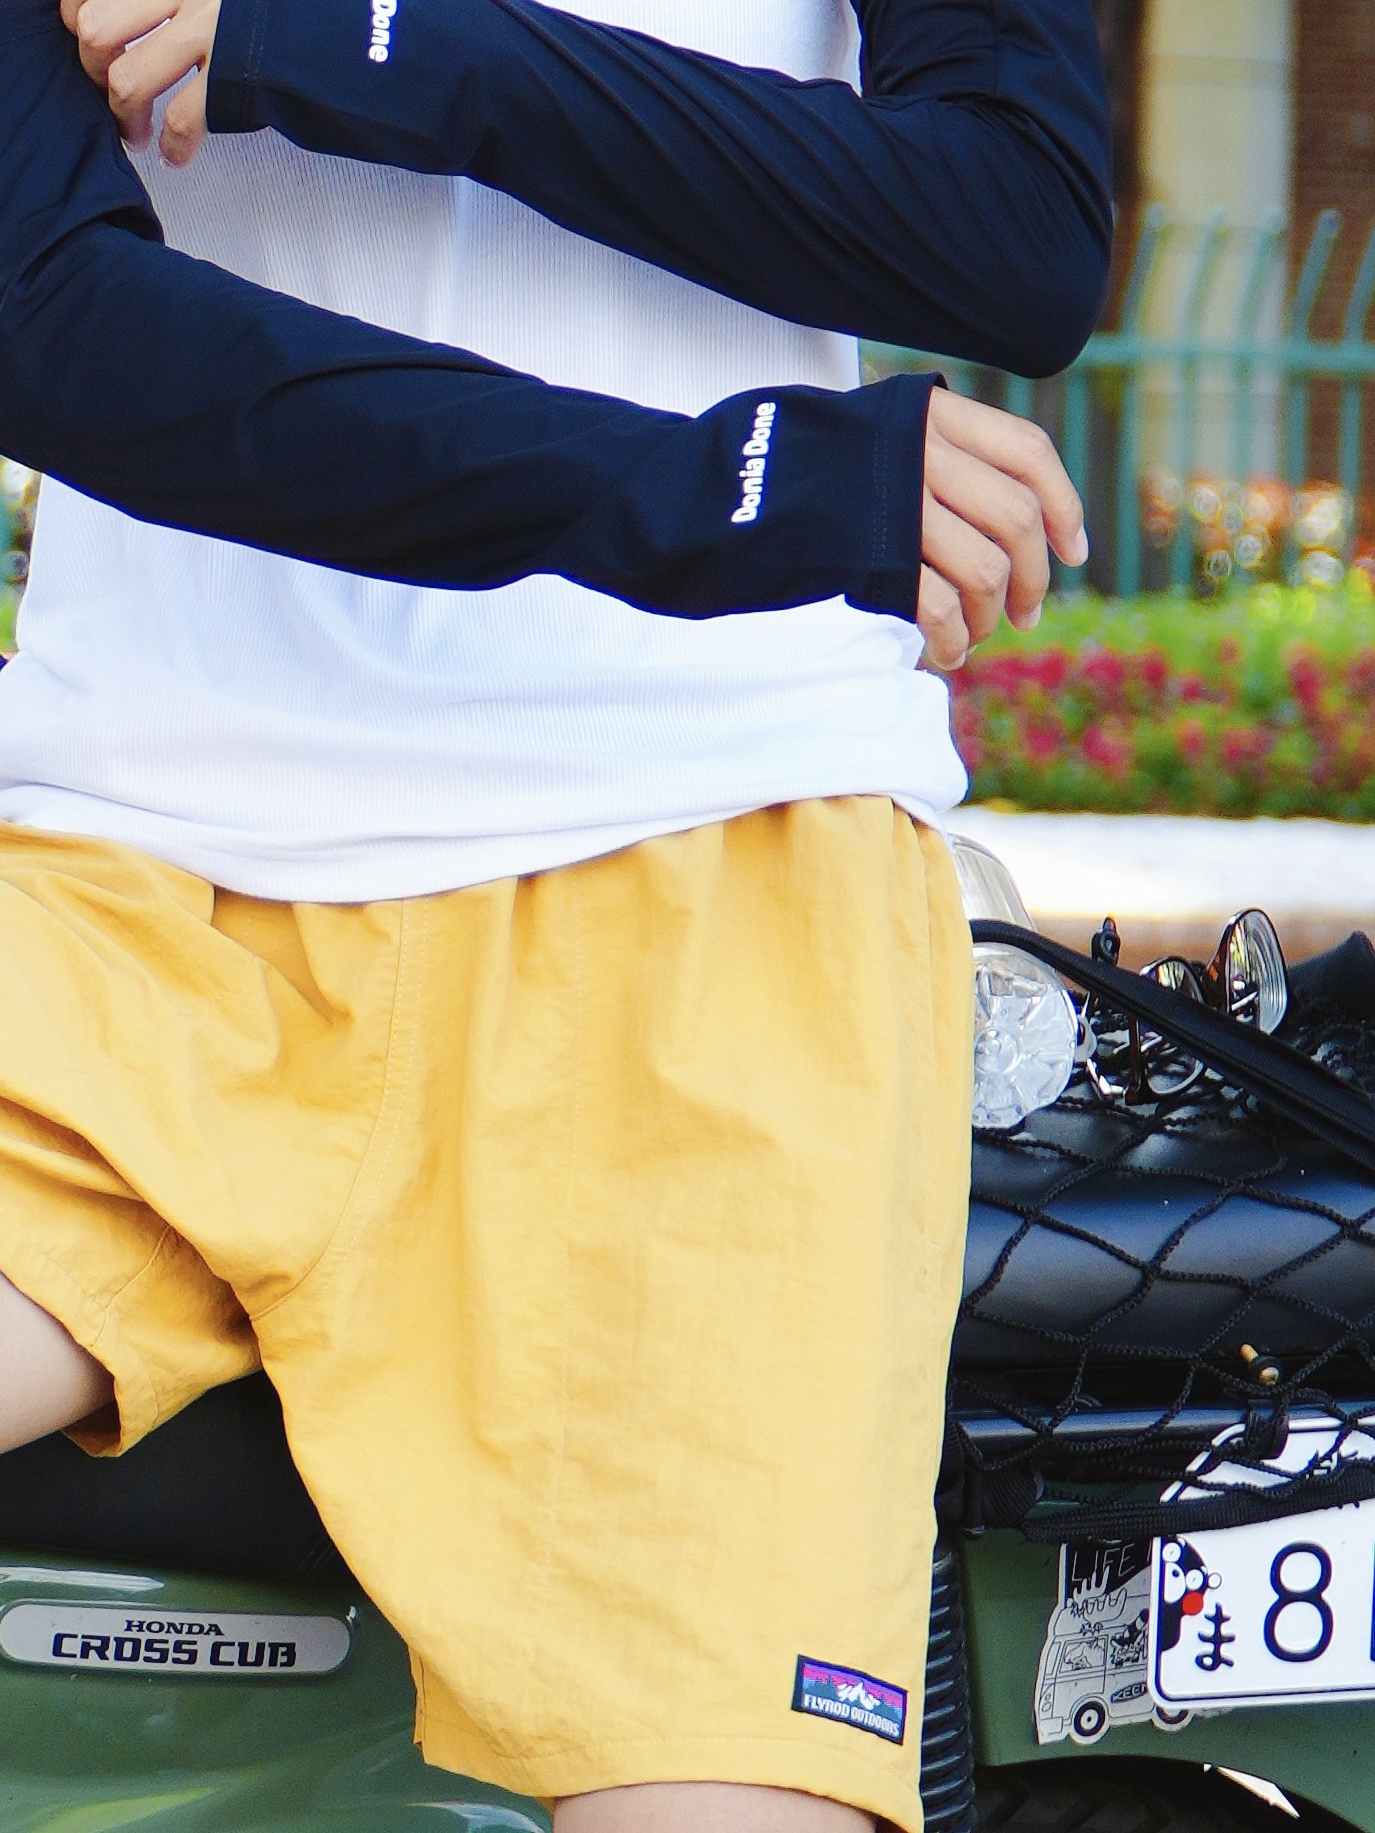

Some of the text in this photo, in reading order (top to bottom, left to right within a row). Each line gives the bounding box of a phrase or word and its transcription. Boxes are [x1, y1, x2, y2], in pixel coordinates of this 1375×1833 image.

[730, 402, 777, 523] Donia Done
[124, 1619, 225, 1637] HONDA
[1263, 1540, 1375, 1664] 8
[52, 1632, 297, 1668] CROSS CUB
[1194, 1602, 1236, 1672] ま
[803, 1693, 901, 1738] FLYROD OUTDOORS
